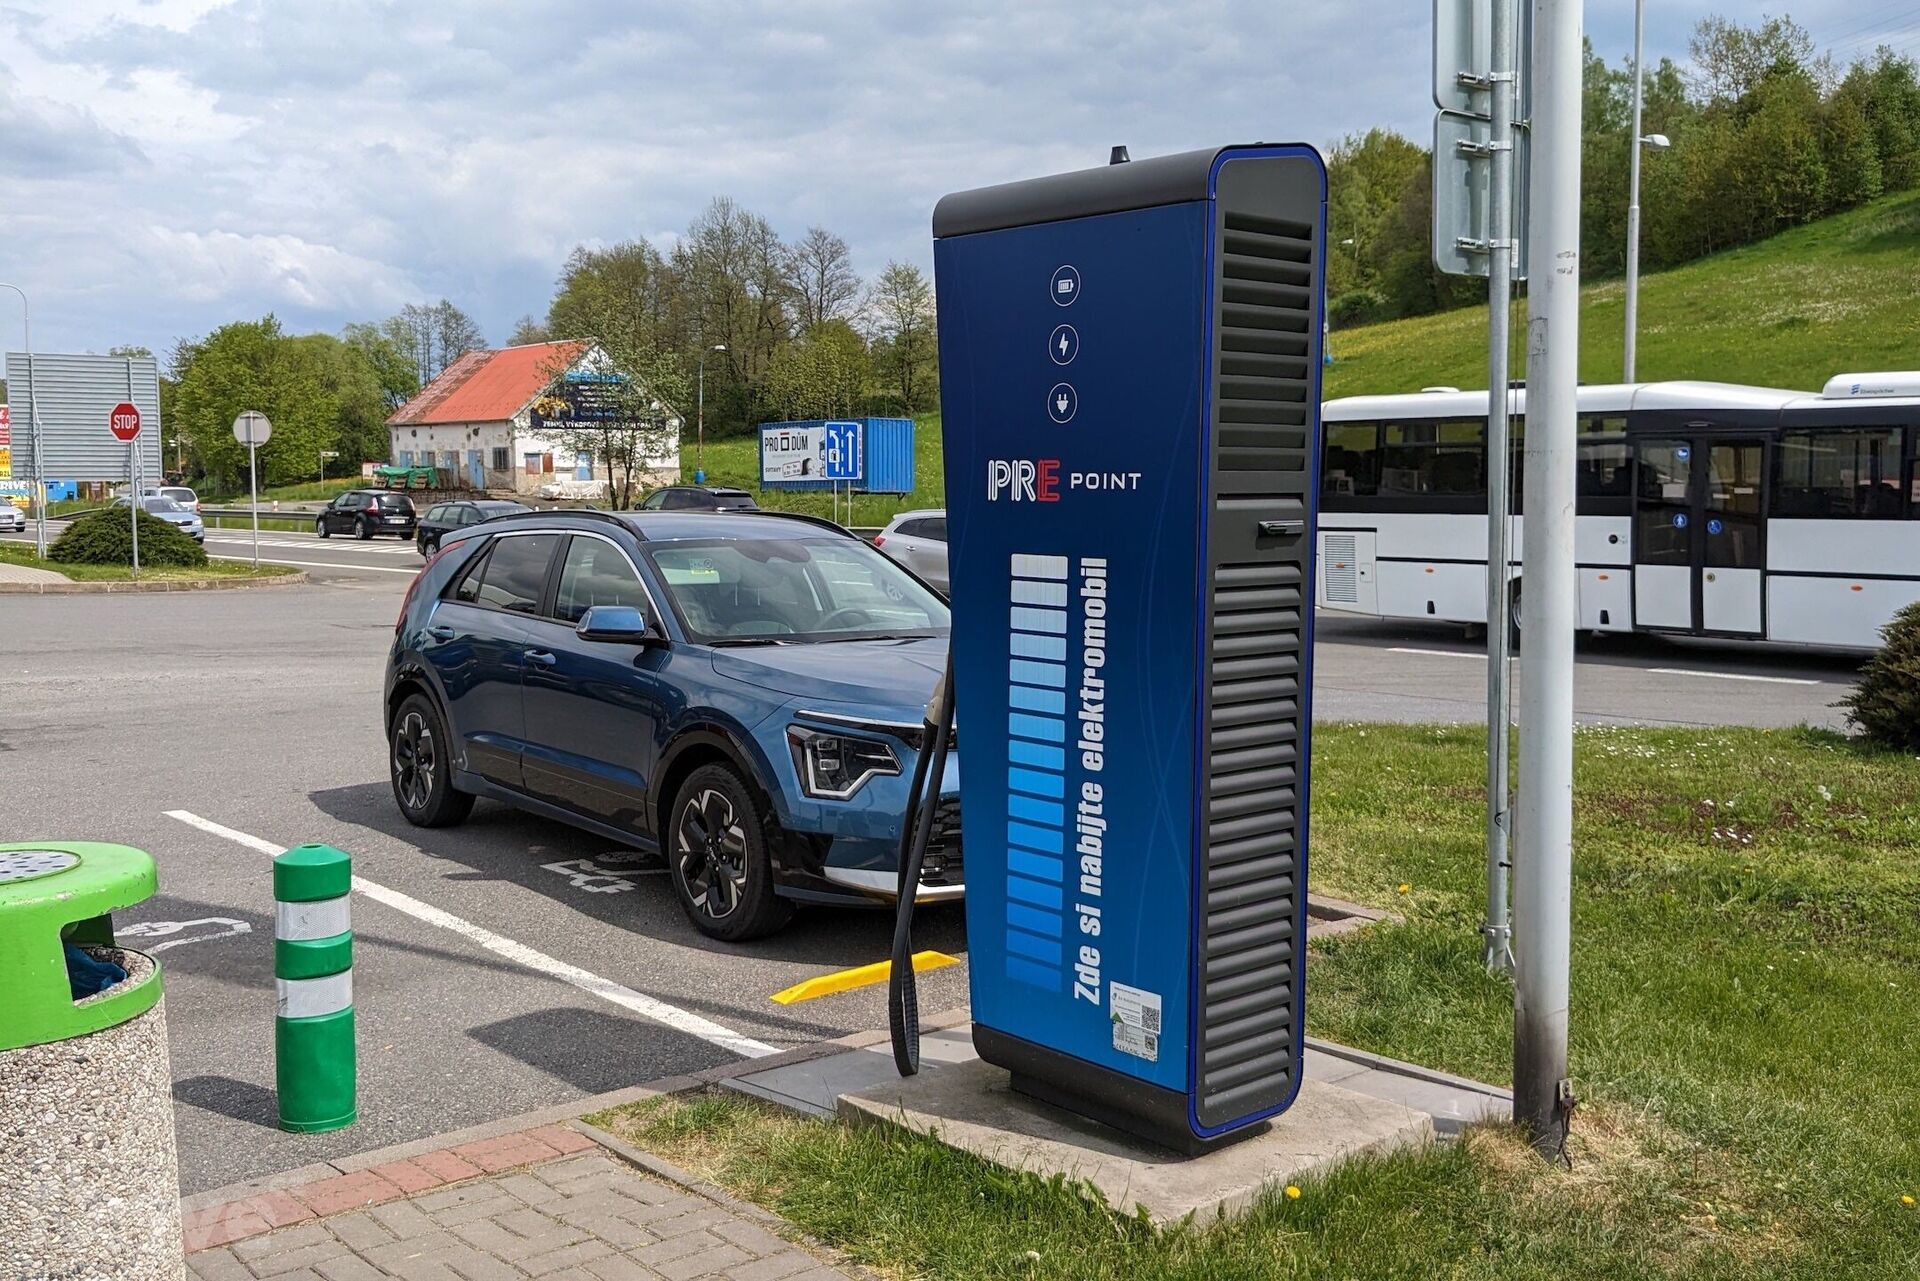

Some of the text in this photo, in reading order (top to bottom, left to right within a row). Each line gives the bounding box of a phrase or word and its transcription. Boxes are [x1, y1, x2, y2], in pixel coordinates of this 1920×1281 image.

[114, 414, 137, 429] STOP
[764, 432, 808, 452] PRO DŮM
[988, 460, 1142, 501] PRE POINT
[1074, 558, 1107, 1006] Zde si nabijte elektromobil
